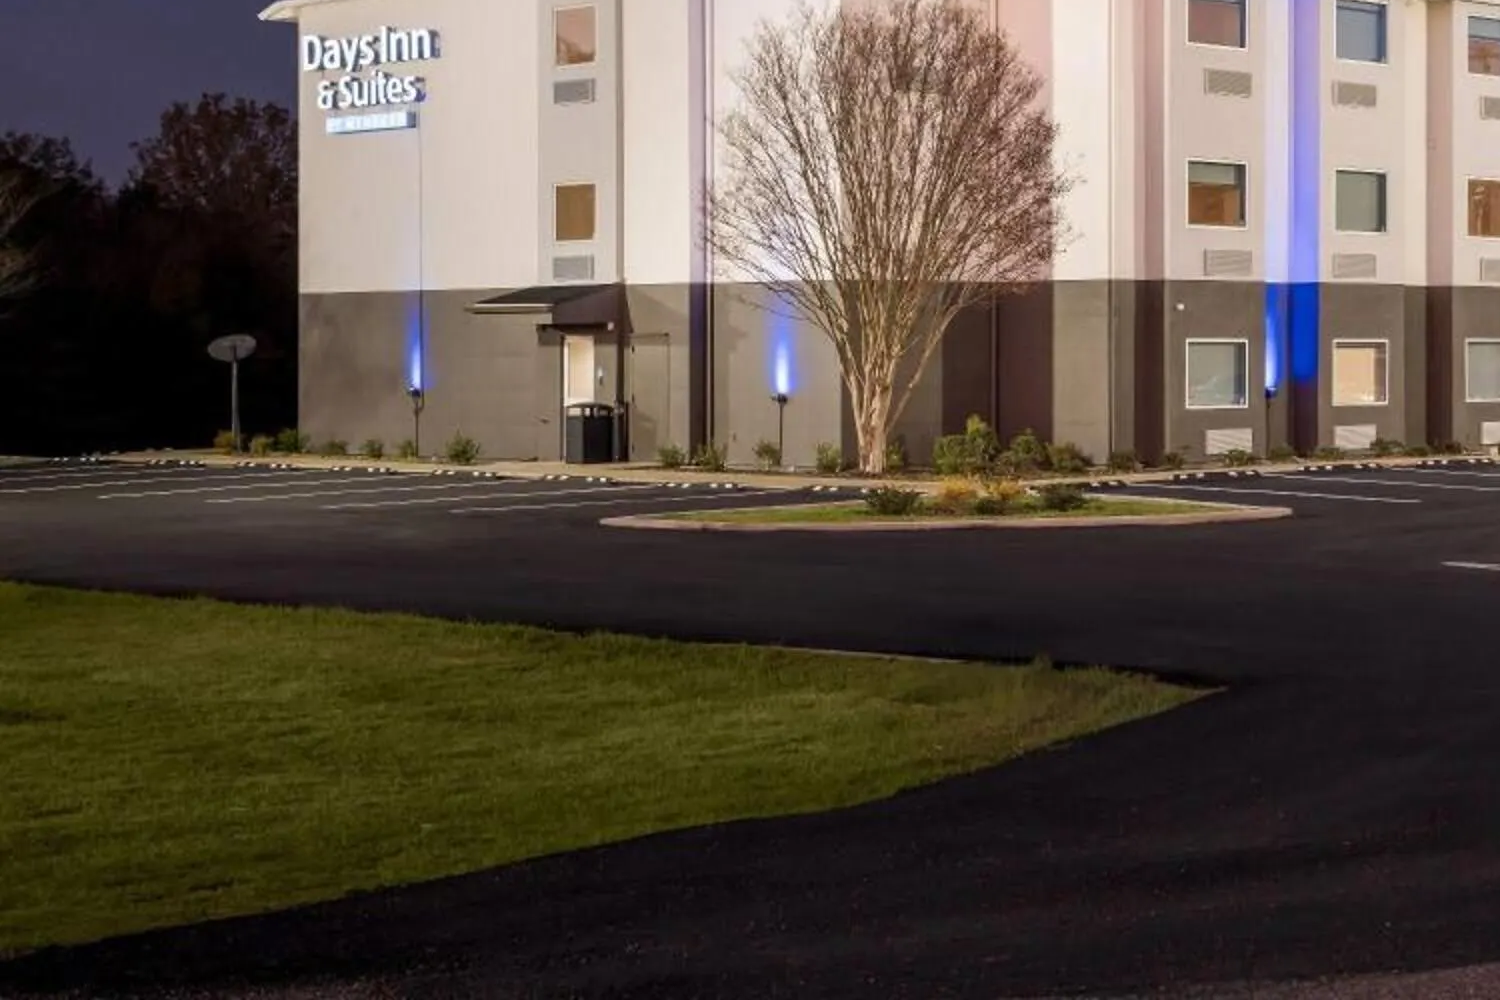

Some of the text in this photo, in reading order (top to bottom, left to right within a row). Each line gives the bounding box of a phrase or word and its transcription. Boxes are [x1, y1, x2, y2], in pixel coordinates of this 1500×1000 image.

[303, 25, 432, 72] Days Inn
[317, 69, 417, 109] & Suites
